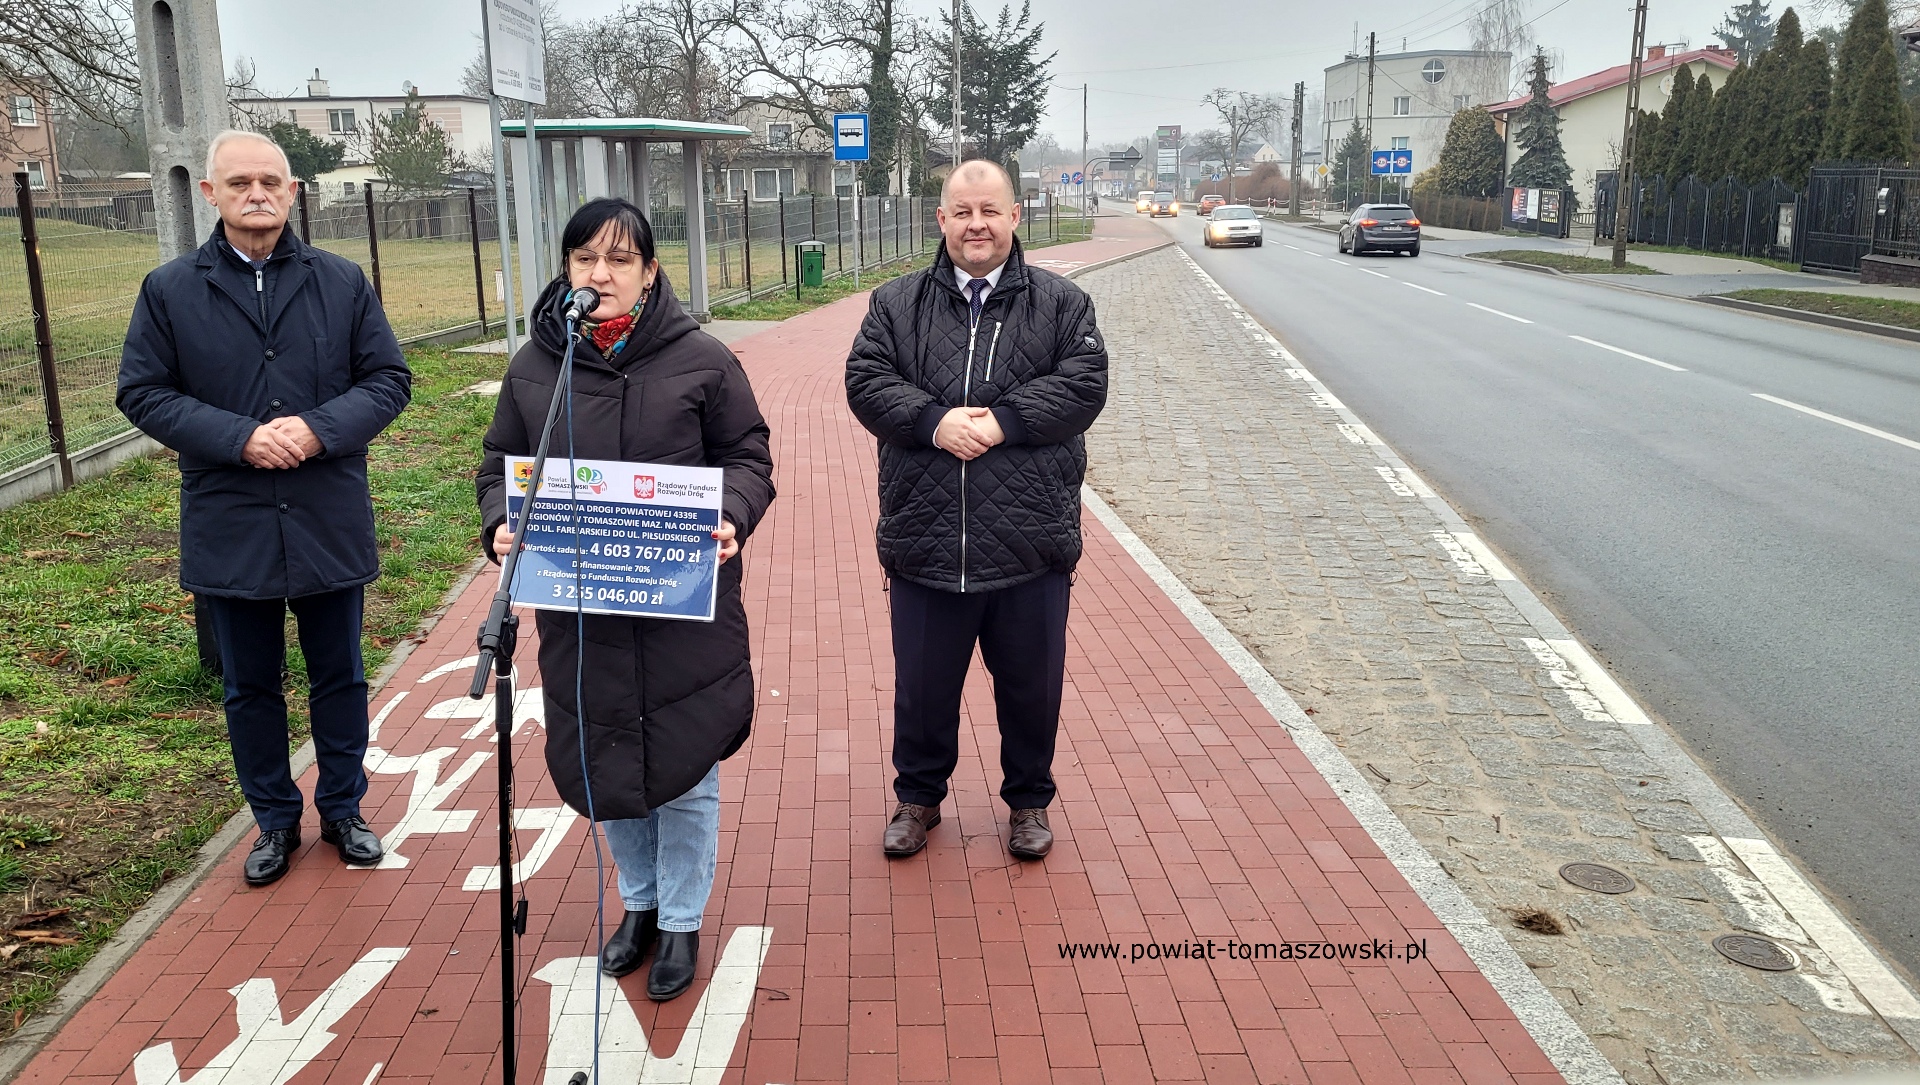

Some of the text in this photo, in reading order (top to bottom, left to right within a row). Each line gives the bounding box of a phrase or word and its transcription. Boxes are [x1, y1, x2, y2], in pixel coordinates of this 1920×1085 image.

[657, 482, 688, 490] Rządowy
[657, 488, 686, 496] Rozwoju
[532, 502, 698, 520] OZBUDOWA DROGI POWIATOWEJ 4339E
[528, 512, 570, 522] EGIONÓW
[583, 516, 640, 527] TOMASZOWIE
[642, 520, 662, 529] MAZ.
[679, 523, 717, 532] ODCINKU
[526, 524, 700, 542] OD UL. FARBARSKIEJ DO UL. PIŁSUDSKIEGO
[524, 544, 556, 552] Wartość
[590, 542, 600, 556] 4
[603, 544, 631, 558] 603
[634, 545, 685, 563] 767,00
[688, 549, 701, 562] zł
[634, 565, 651, 573] 70%
[542, 570, 586, 580] Rządoweo
[588, 573, 624, 582] Funduszu
[625, 576, 658, 586] Rozwoju
[659, 578, 678, 588] Dróg
[552, 584, 664, 605] 3 255 046,00 zł
